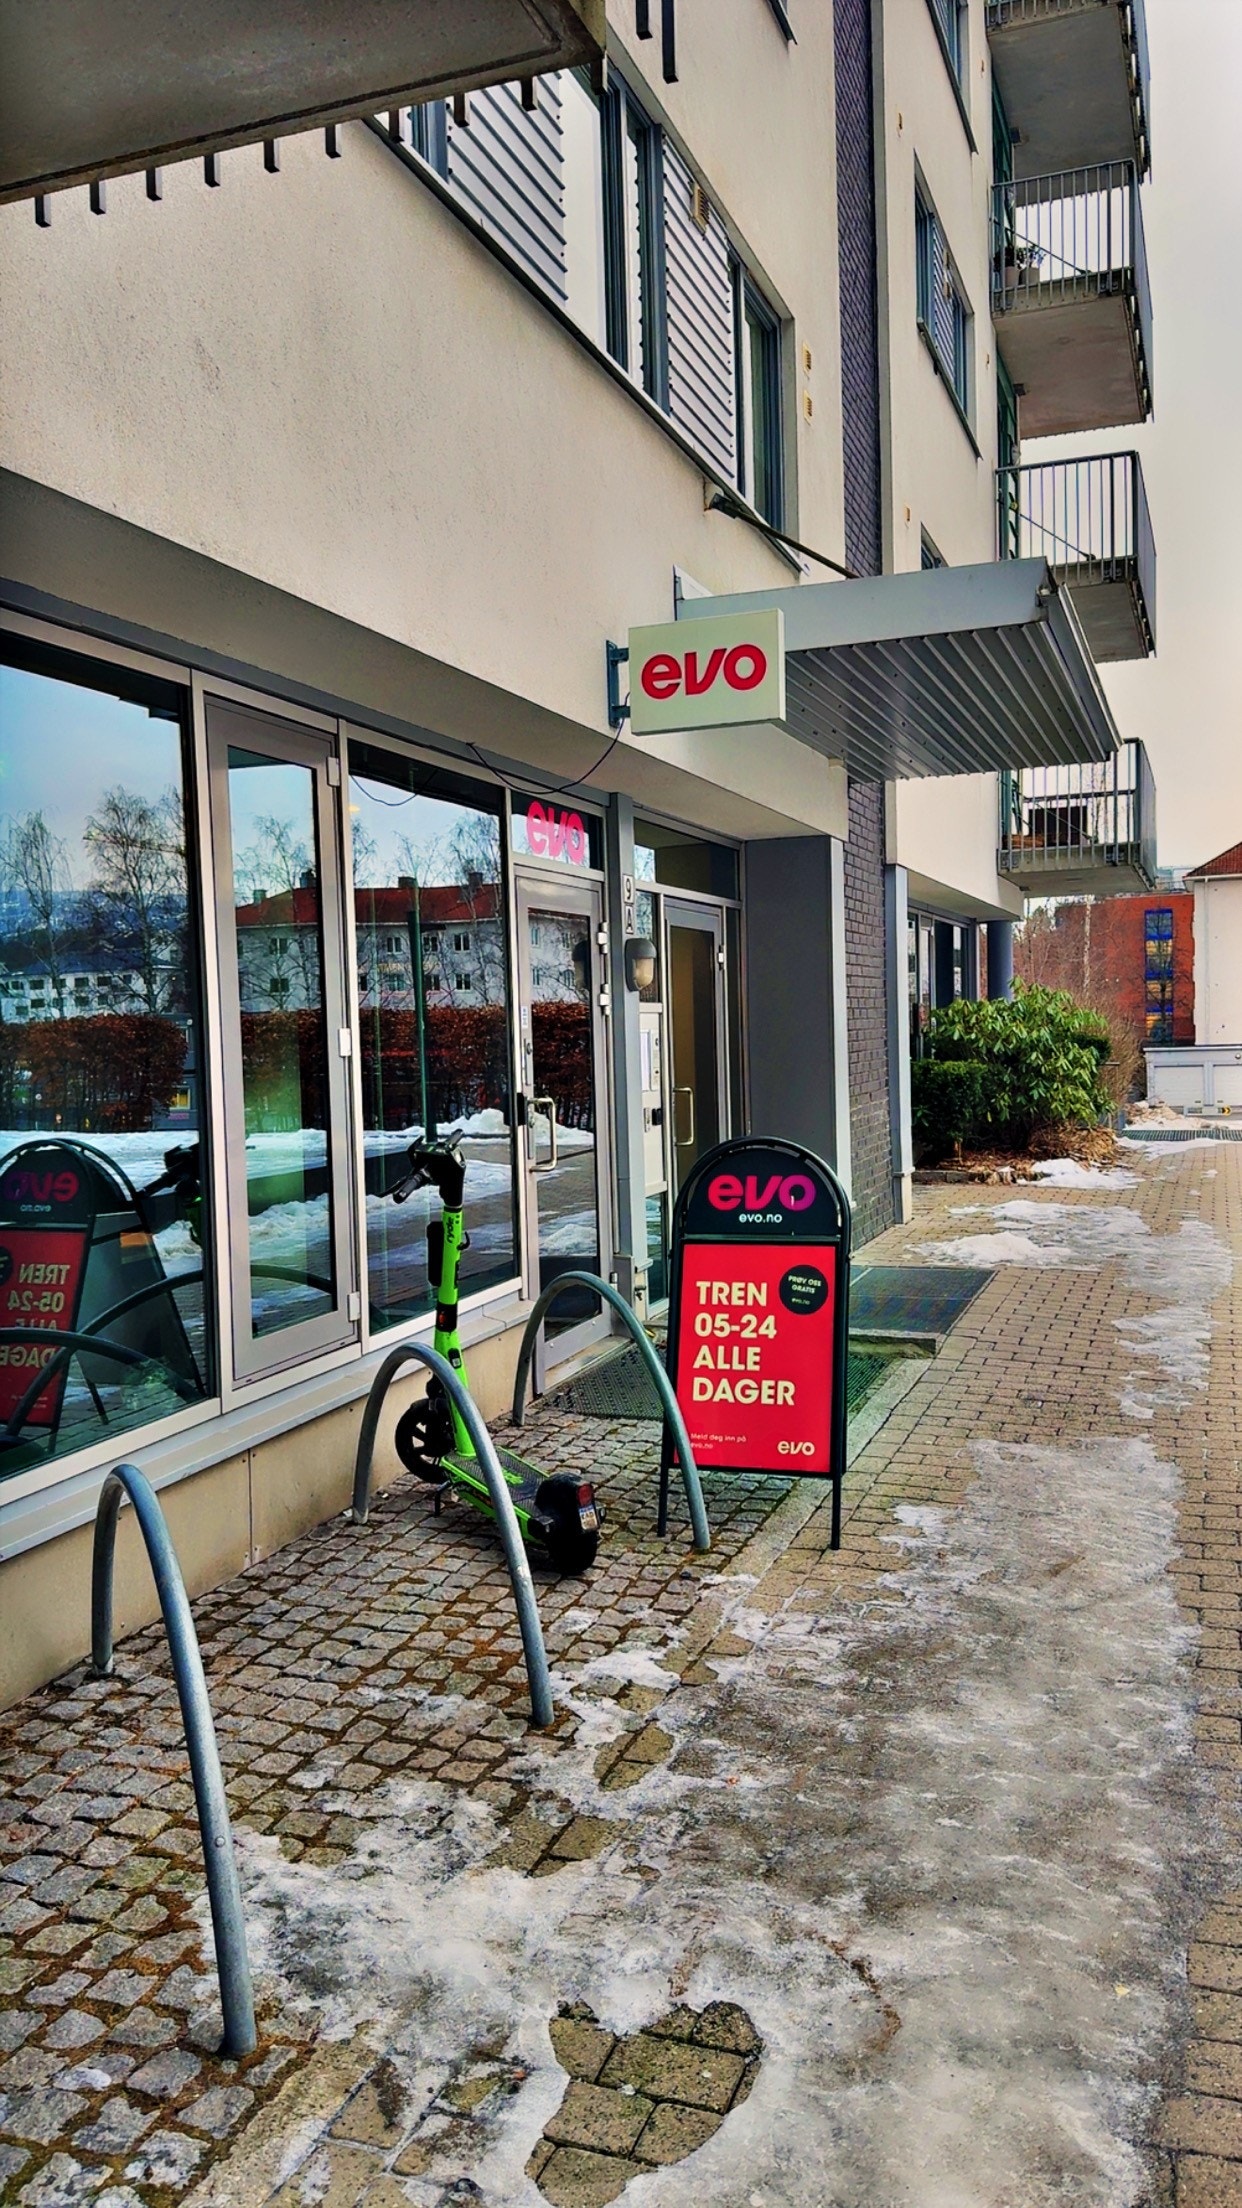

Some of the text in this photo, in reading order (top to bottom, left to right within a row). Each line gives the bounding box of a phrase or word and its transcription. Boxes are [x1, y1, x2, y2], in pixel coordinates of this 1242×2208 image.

[641, 643, 767, 700] evo
[526, 800, 586, 864] evo
[708, 1174, 817, 1211] evo
[739, 1213, 783, 1223] evo.no
[695, 1280, 768, 1307] TREN
[694, 1312, 778, 1339] 05-24
[692, 1344, 761, 1371] ALLE
[692, 1376, 796, 1406] DAGER
[777, 1441, 815, 1456] evo
